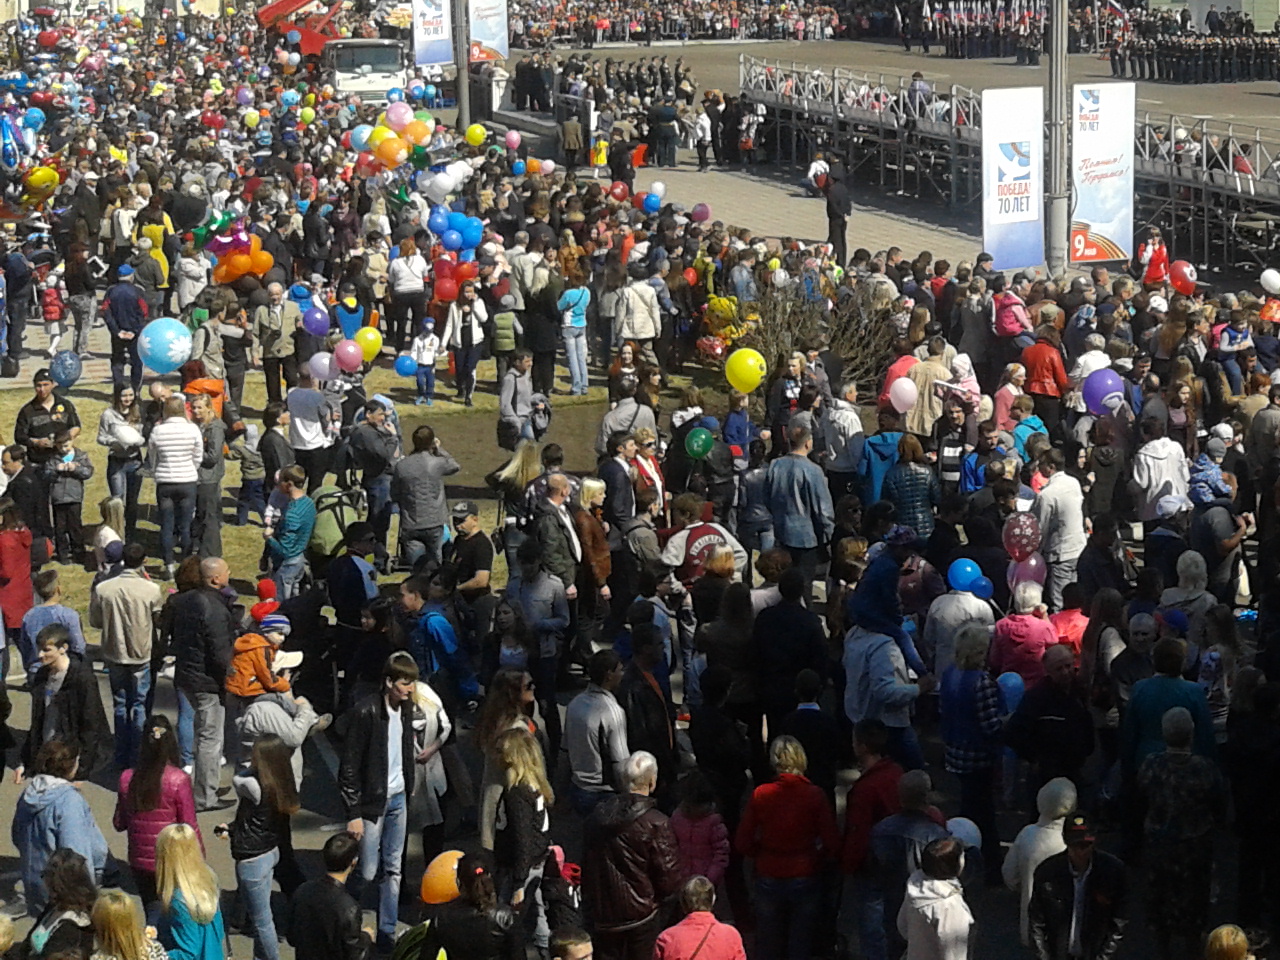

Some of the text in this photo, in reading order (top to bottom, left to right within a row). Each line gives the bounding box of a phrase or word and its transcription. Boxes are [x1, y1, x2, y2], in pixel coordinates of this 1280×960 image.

[472, 46, 480, 59] 9
[1079, 121, 1087, 132] 70
[997, 181, 1031, 197] ПОБЕДА!
[998, 196, 1031, 214] 70 ЛЕТ
[1074, 234, 1085, 257] 9
